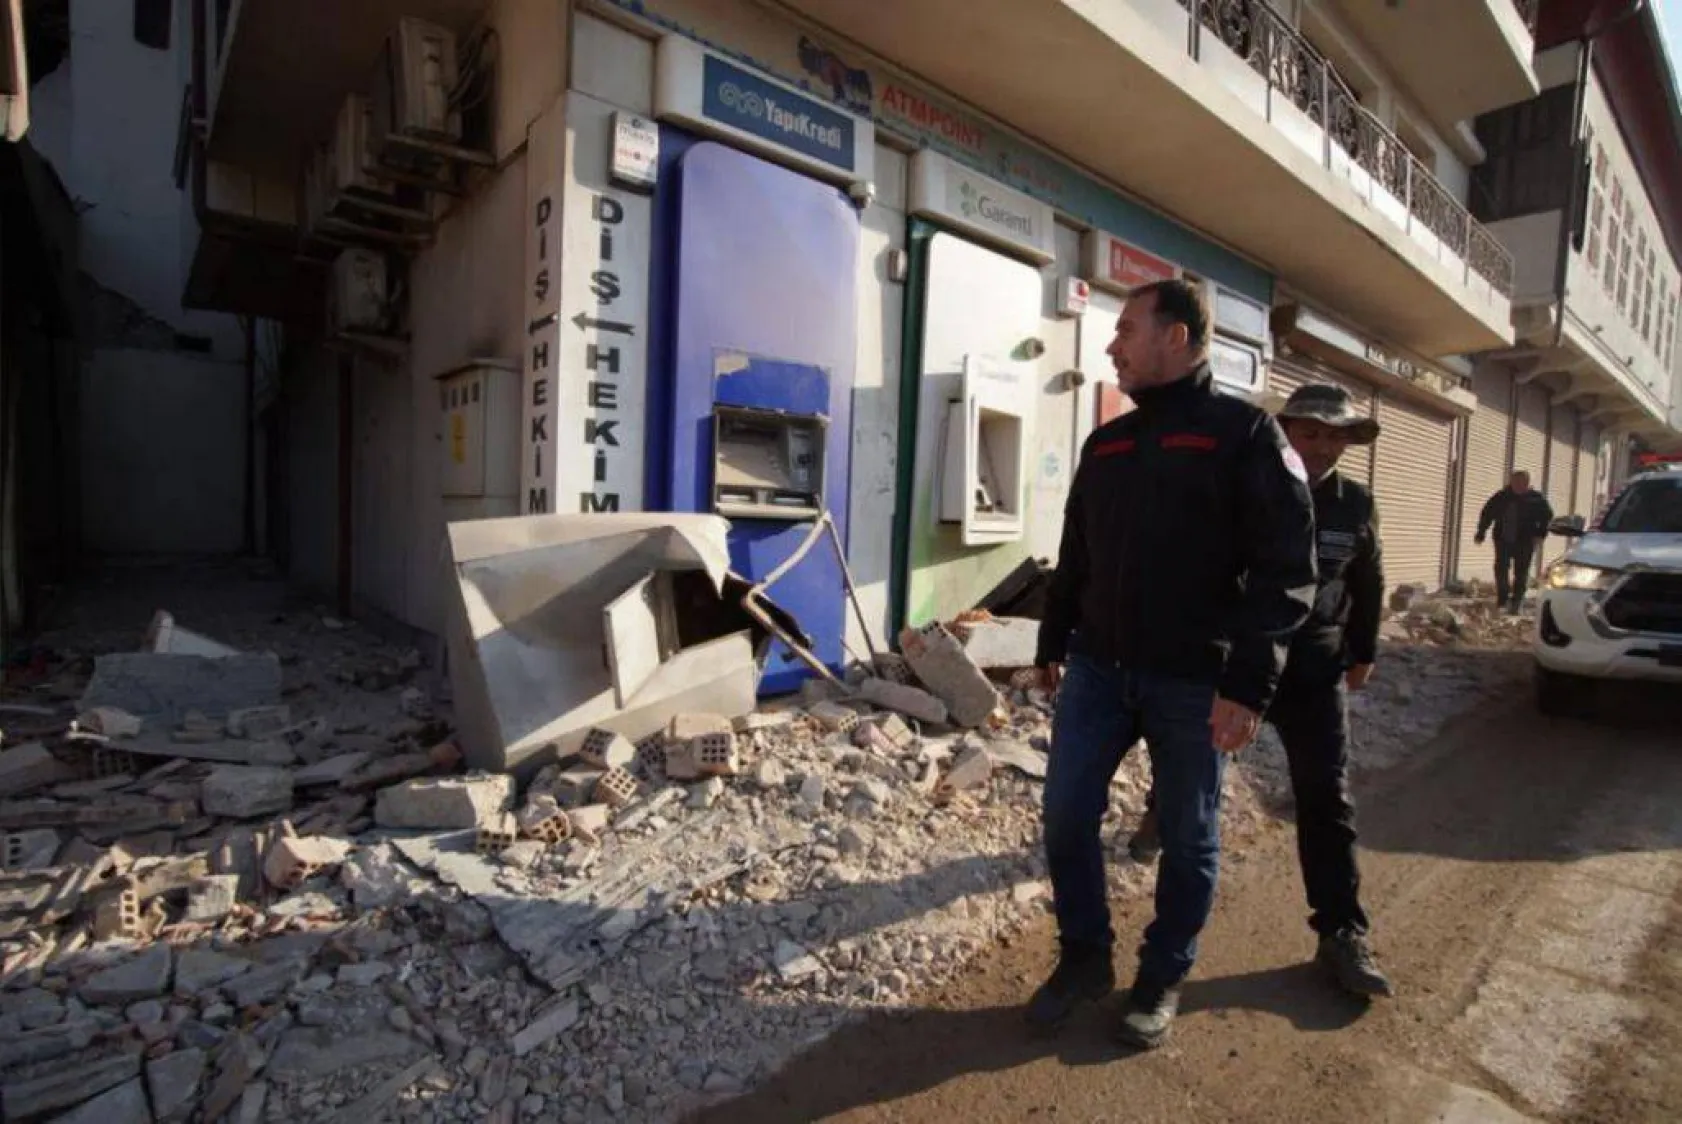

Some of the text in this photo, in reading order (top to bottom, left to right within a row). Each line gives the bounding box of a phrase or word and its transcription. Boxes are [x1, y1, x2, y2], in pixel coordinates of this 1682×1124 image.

[882, 84, 985, 151] ATMPOINT
[979, 195, 1032, 237] Garanti
[579, 195, 624, 513] DİŞ HEKİM
